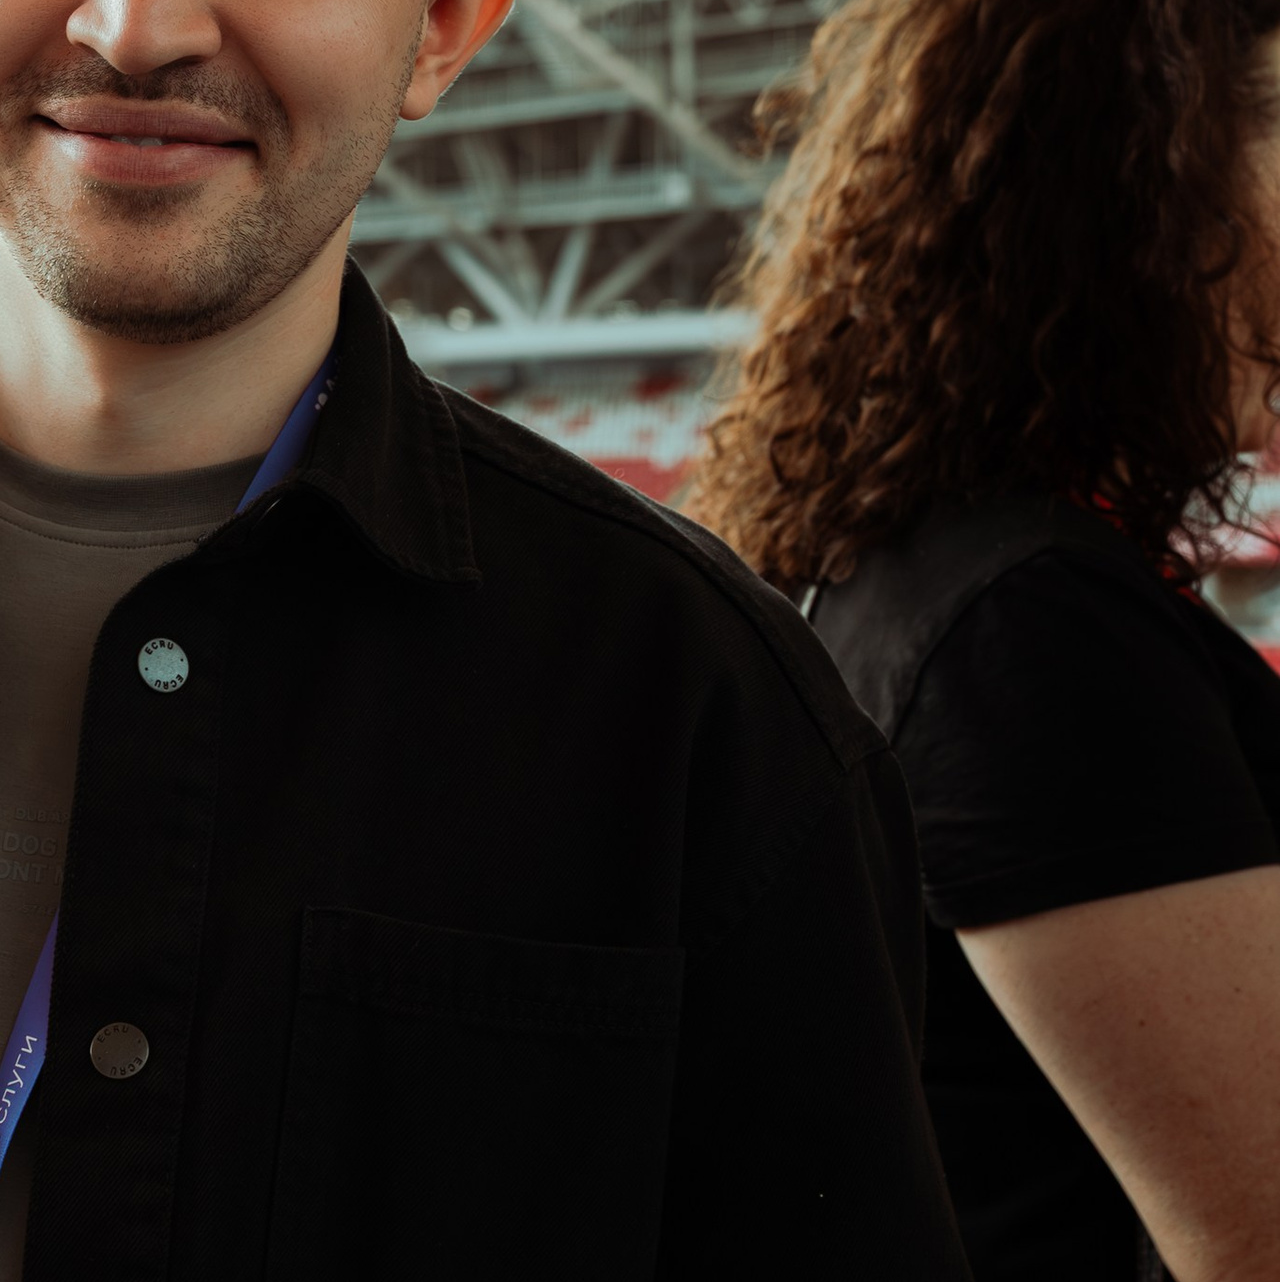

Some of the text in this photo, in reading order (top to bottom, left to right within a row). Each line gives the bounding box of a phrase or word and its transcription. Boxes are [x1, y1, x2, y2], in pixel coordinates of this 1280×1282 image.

[144, 640, 174, 655] ECRU
[154, 674, 184, 689] ECRU
[2, 830, 57, 856] DOG
[97, 1024, 129, 1043] ECRU
[110, 1057, 143, 1076] ECRU
